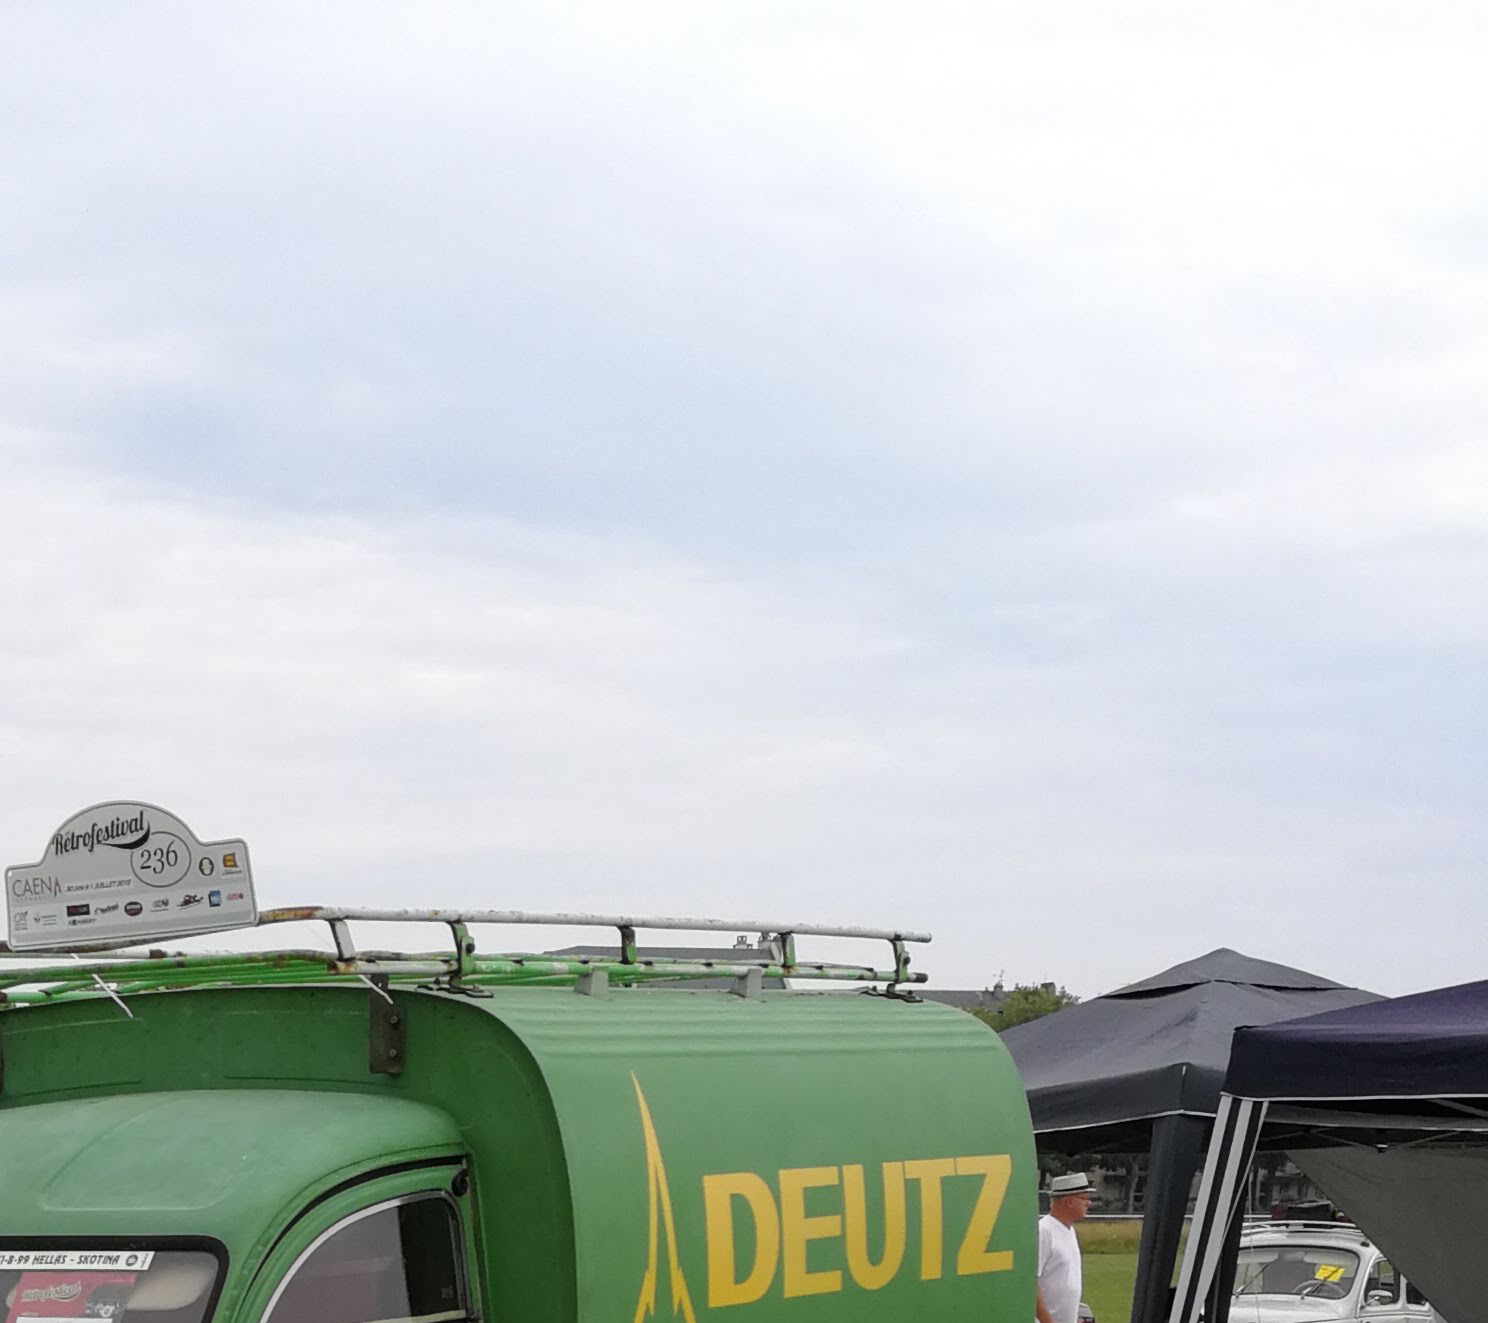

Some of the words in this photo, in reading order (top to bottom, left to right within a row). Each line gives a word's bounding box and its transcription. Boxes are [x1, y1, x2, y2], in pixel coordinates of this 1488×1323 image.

[140, 840, 178, 875] 236
[702, 1154, 1013, 1308] DEUTZ
[32, 1255, 68, 1265] HELLAS
[77, 1255, 120, 1265] SKOTINA
